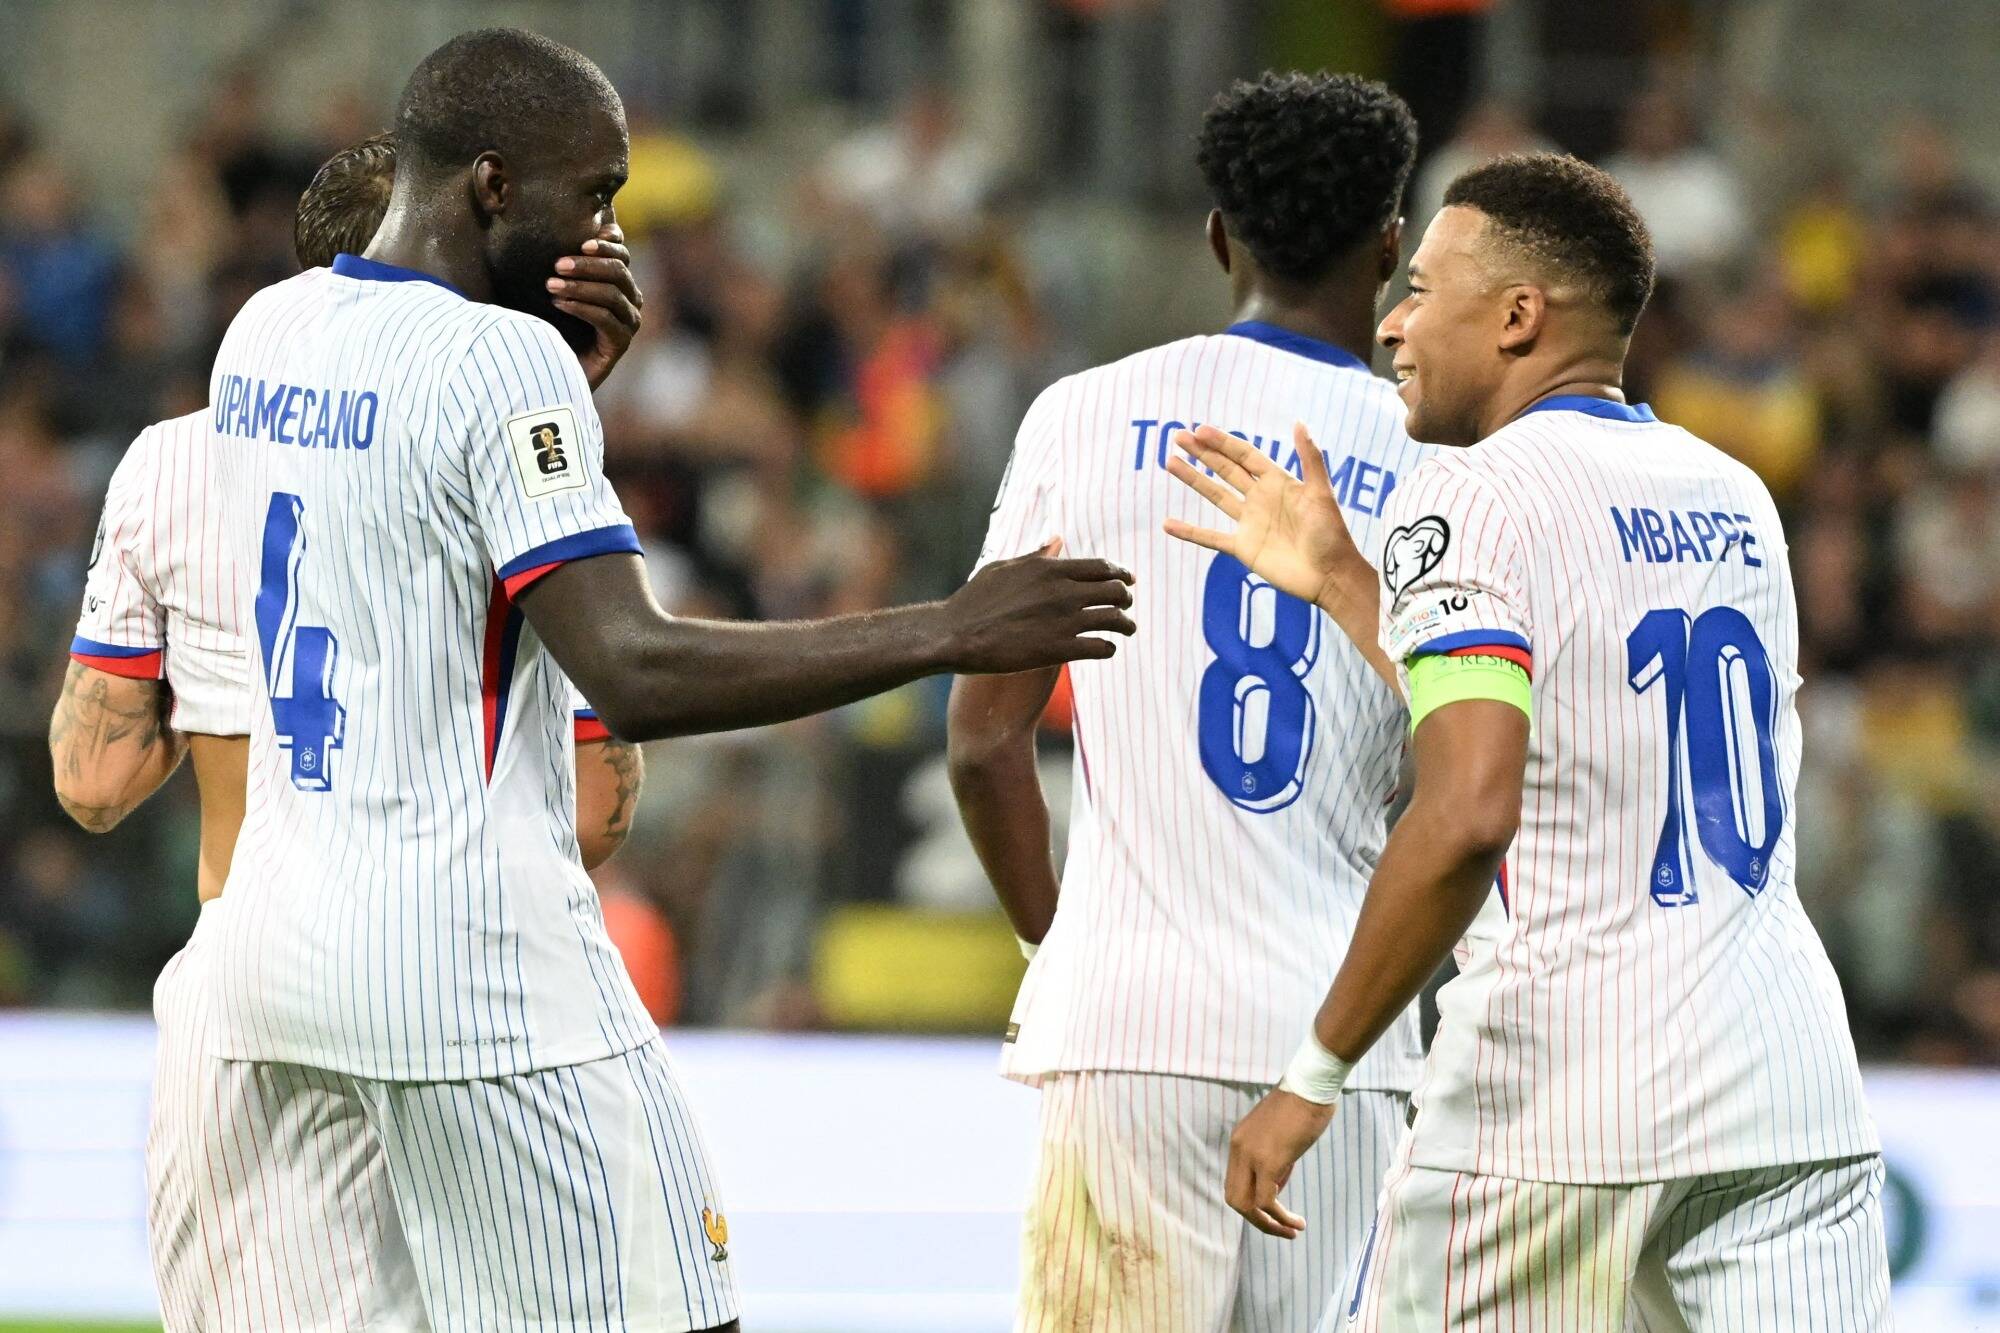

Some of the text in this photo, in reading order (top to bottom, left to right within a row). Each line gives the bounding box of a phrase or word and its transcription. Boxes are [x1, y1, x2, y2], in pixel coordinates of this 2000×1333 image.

[216, 375, 378, 450] UPAMECANO
[1610, 506, 1762, 568] MBAPPE
[254, 491, 346, 791] 4
[1198, 550, 1321, 814] 8
[1626, 605, 1788, 907] 10
